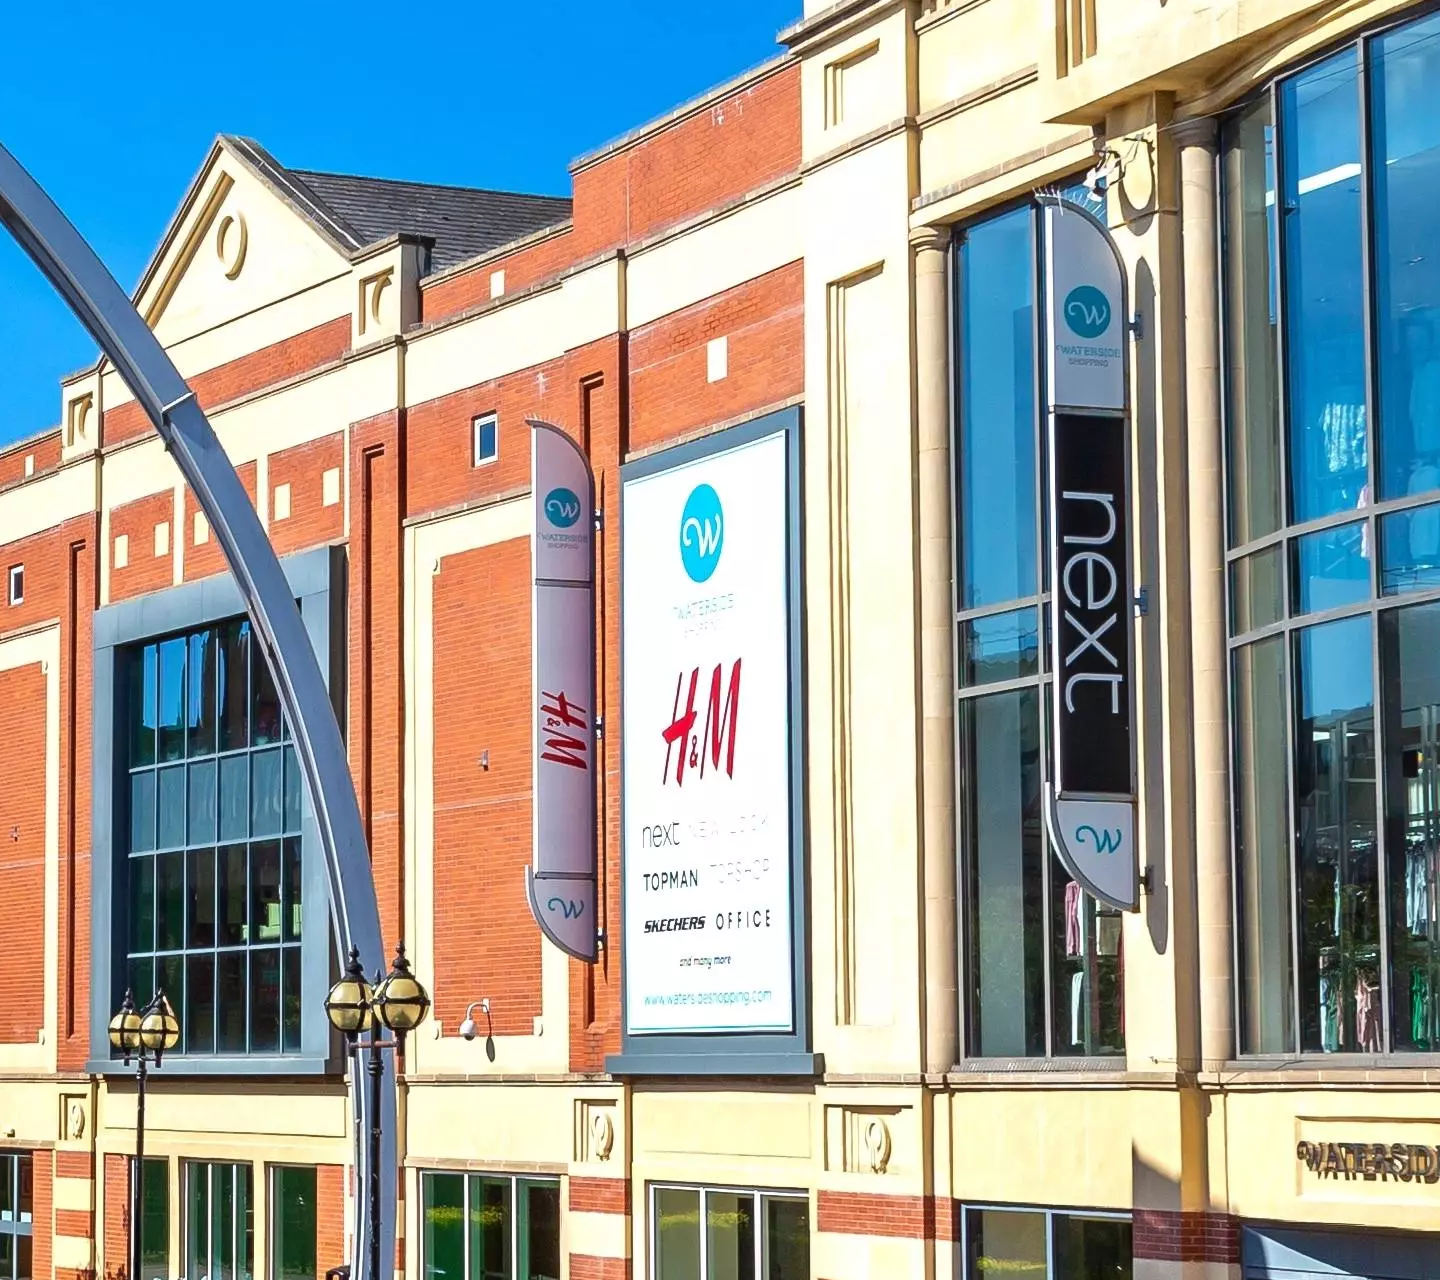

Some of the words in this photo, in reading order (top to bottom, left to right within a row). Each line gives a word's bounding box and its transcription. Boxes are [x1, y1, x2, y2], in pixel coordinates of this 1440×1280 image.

[1055, 343, 1121, 359] WATERSIDE
[1068, 357, 1109, 368] SHOPPING
[537, 533, 588, 544] WATERSIDE
[547, 542, 579, 550] SHOPPING
[1062, 489, 1124, 715] next
[540, 691, 588, 771] H&M
[661, 657, 742, 788] H&M
[642, 823, 680, 848] next
[643, 869, 698, 891] TOPMAN
[644, 916, 706, 934] SKECHERS
[716, 909, 771, 930] OFFICE
[679, 956, 692, 967] and
[693, 957, 712, 969] many
[713, 956, 731, 965] more
